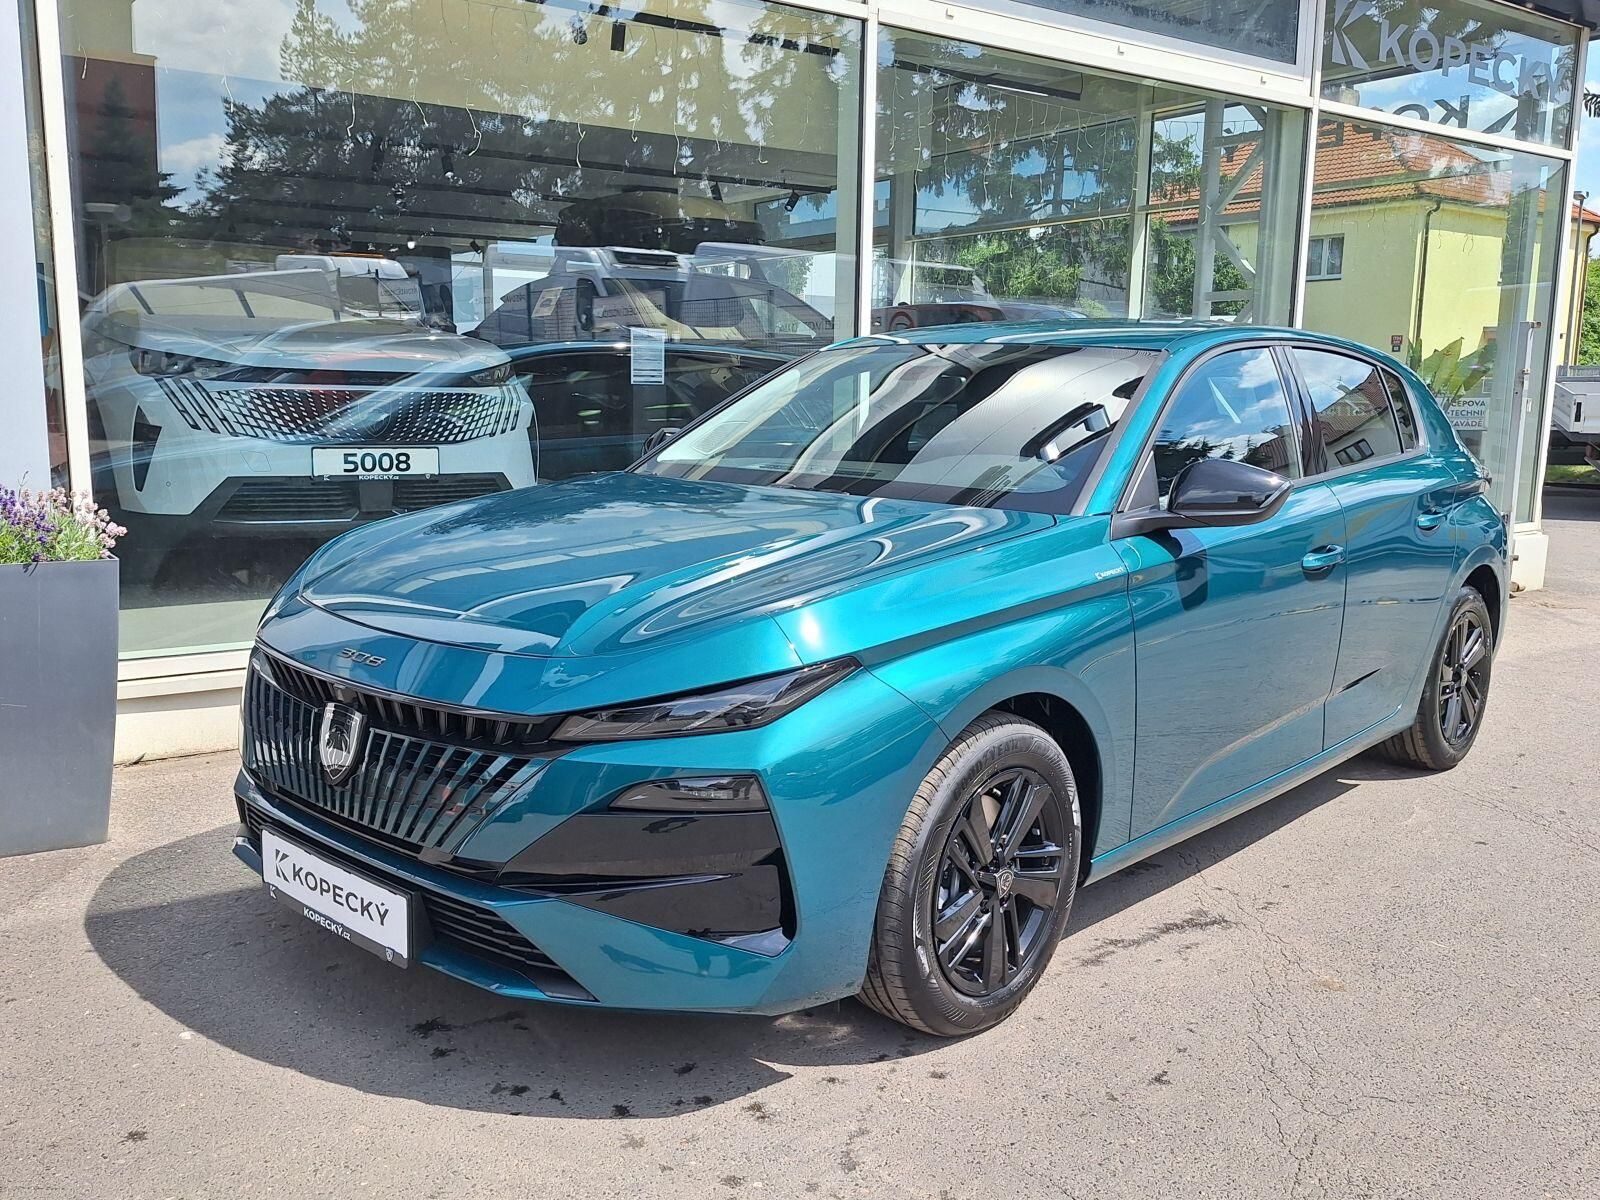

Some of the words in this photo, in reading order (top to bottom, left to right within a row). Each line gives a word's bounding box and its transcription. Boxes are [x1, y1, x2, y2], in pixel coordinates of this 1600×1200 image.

[343, 452, 411, 473] 5008
[338, 647, 387, 667] 308
[292, 862, 390, 926] KOPECKÝ
[303, 906, 351, 940] KOPECKÝ.cz
